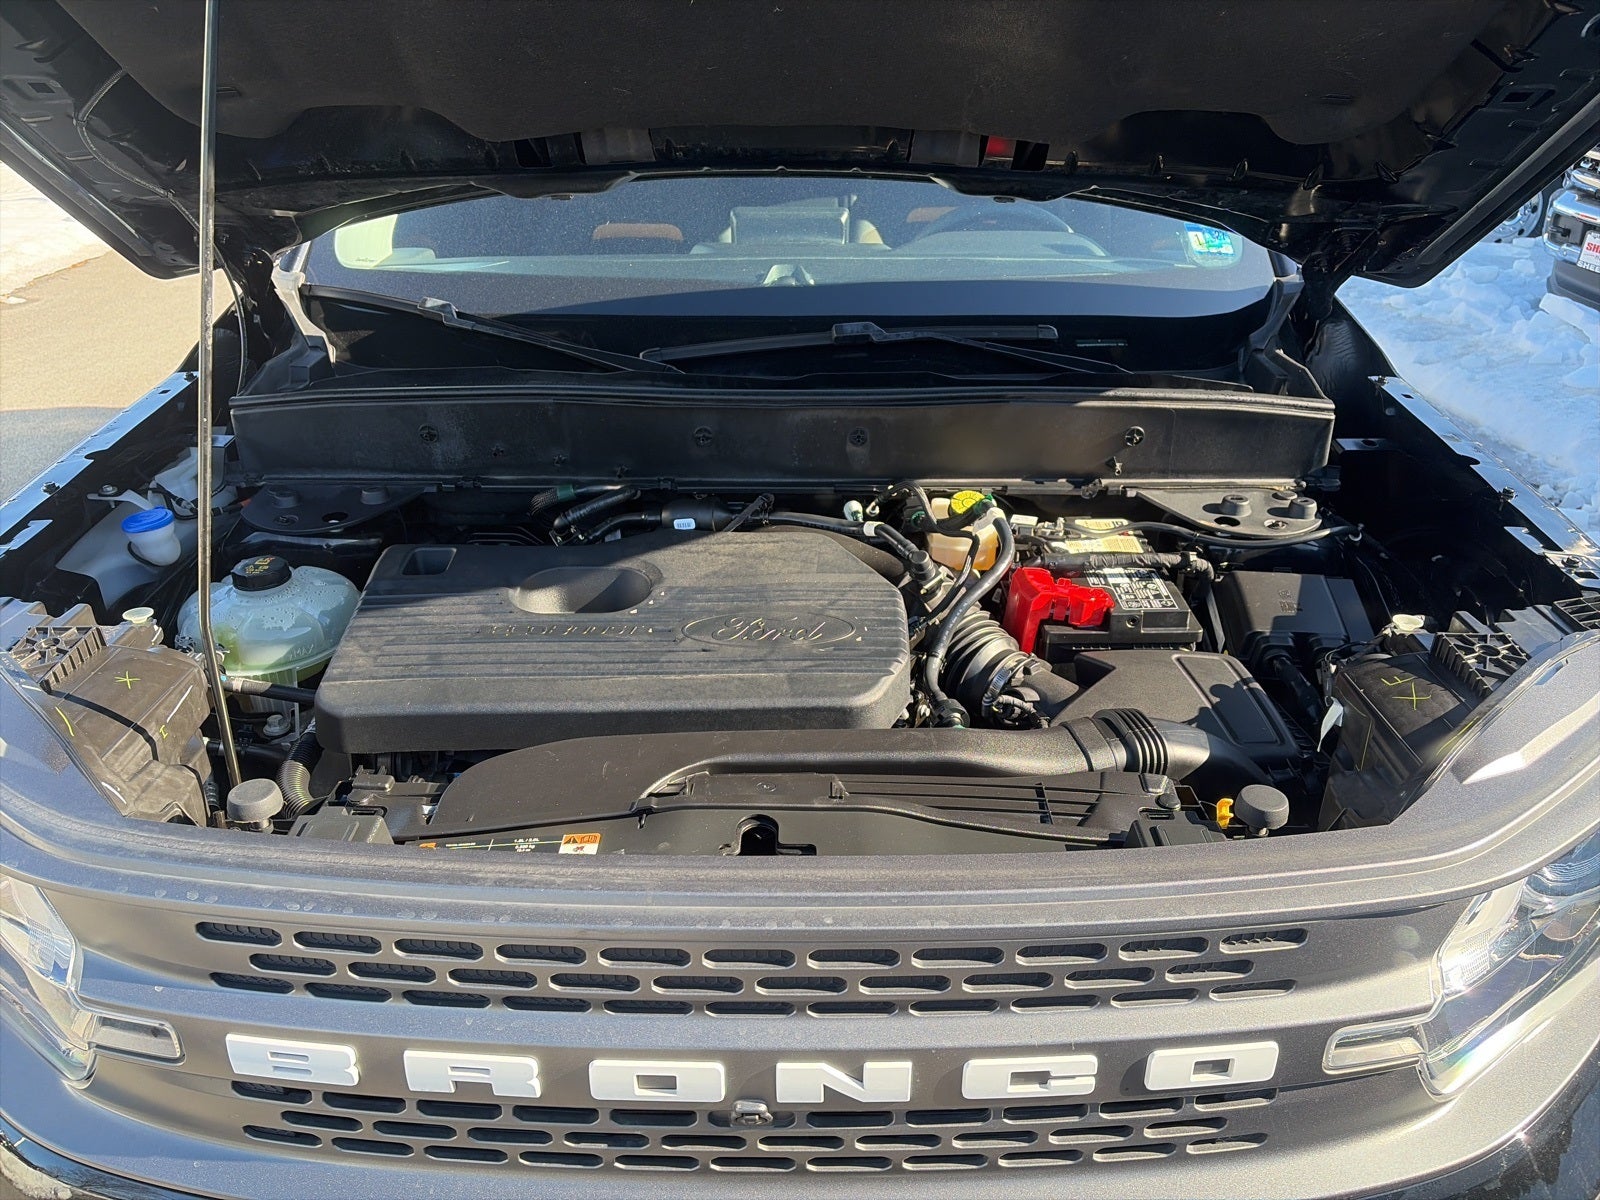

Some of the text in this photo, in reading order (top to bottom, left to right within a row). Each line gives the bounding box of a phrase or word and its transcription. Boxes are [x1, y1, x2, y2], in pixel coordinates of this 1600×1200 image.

[1586, 242, 1600, 254] SH
[712, 616, 826, 641] Ford
[226, 1033, 1279, 1103] BRONCO
